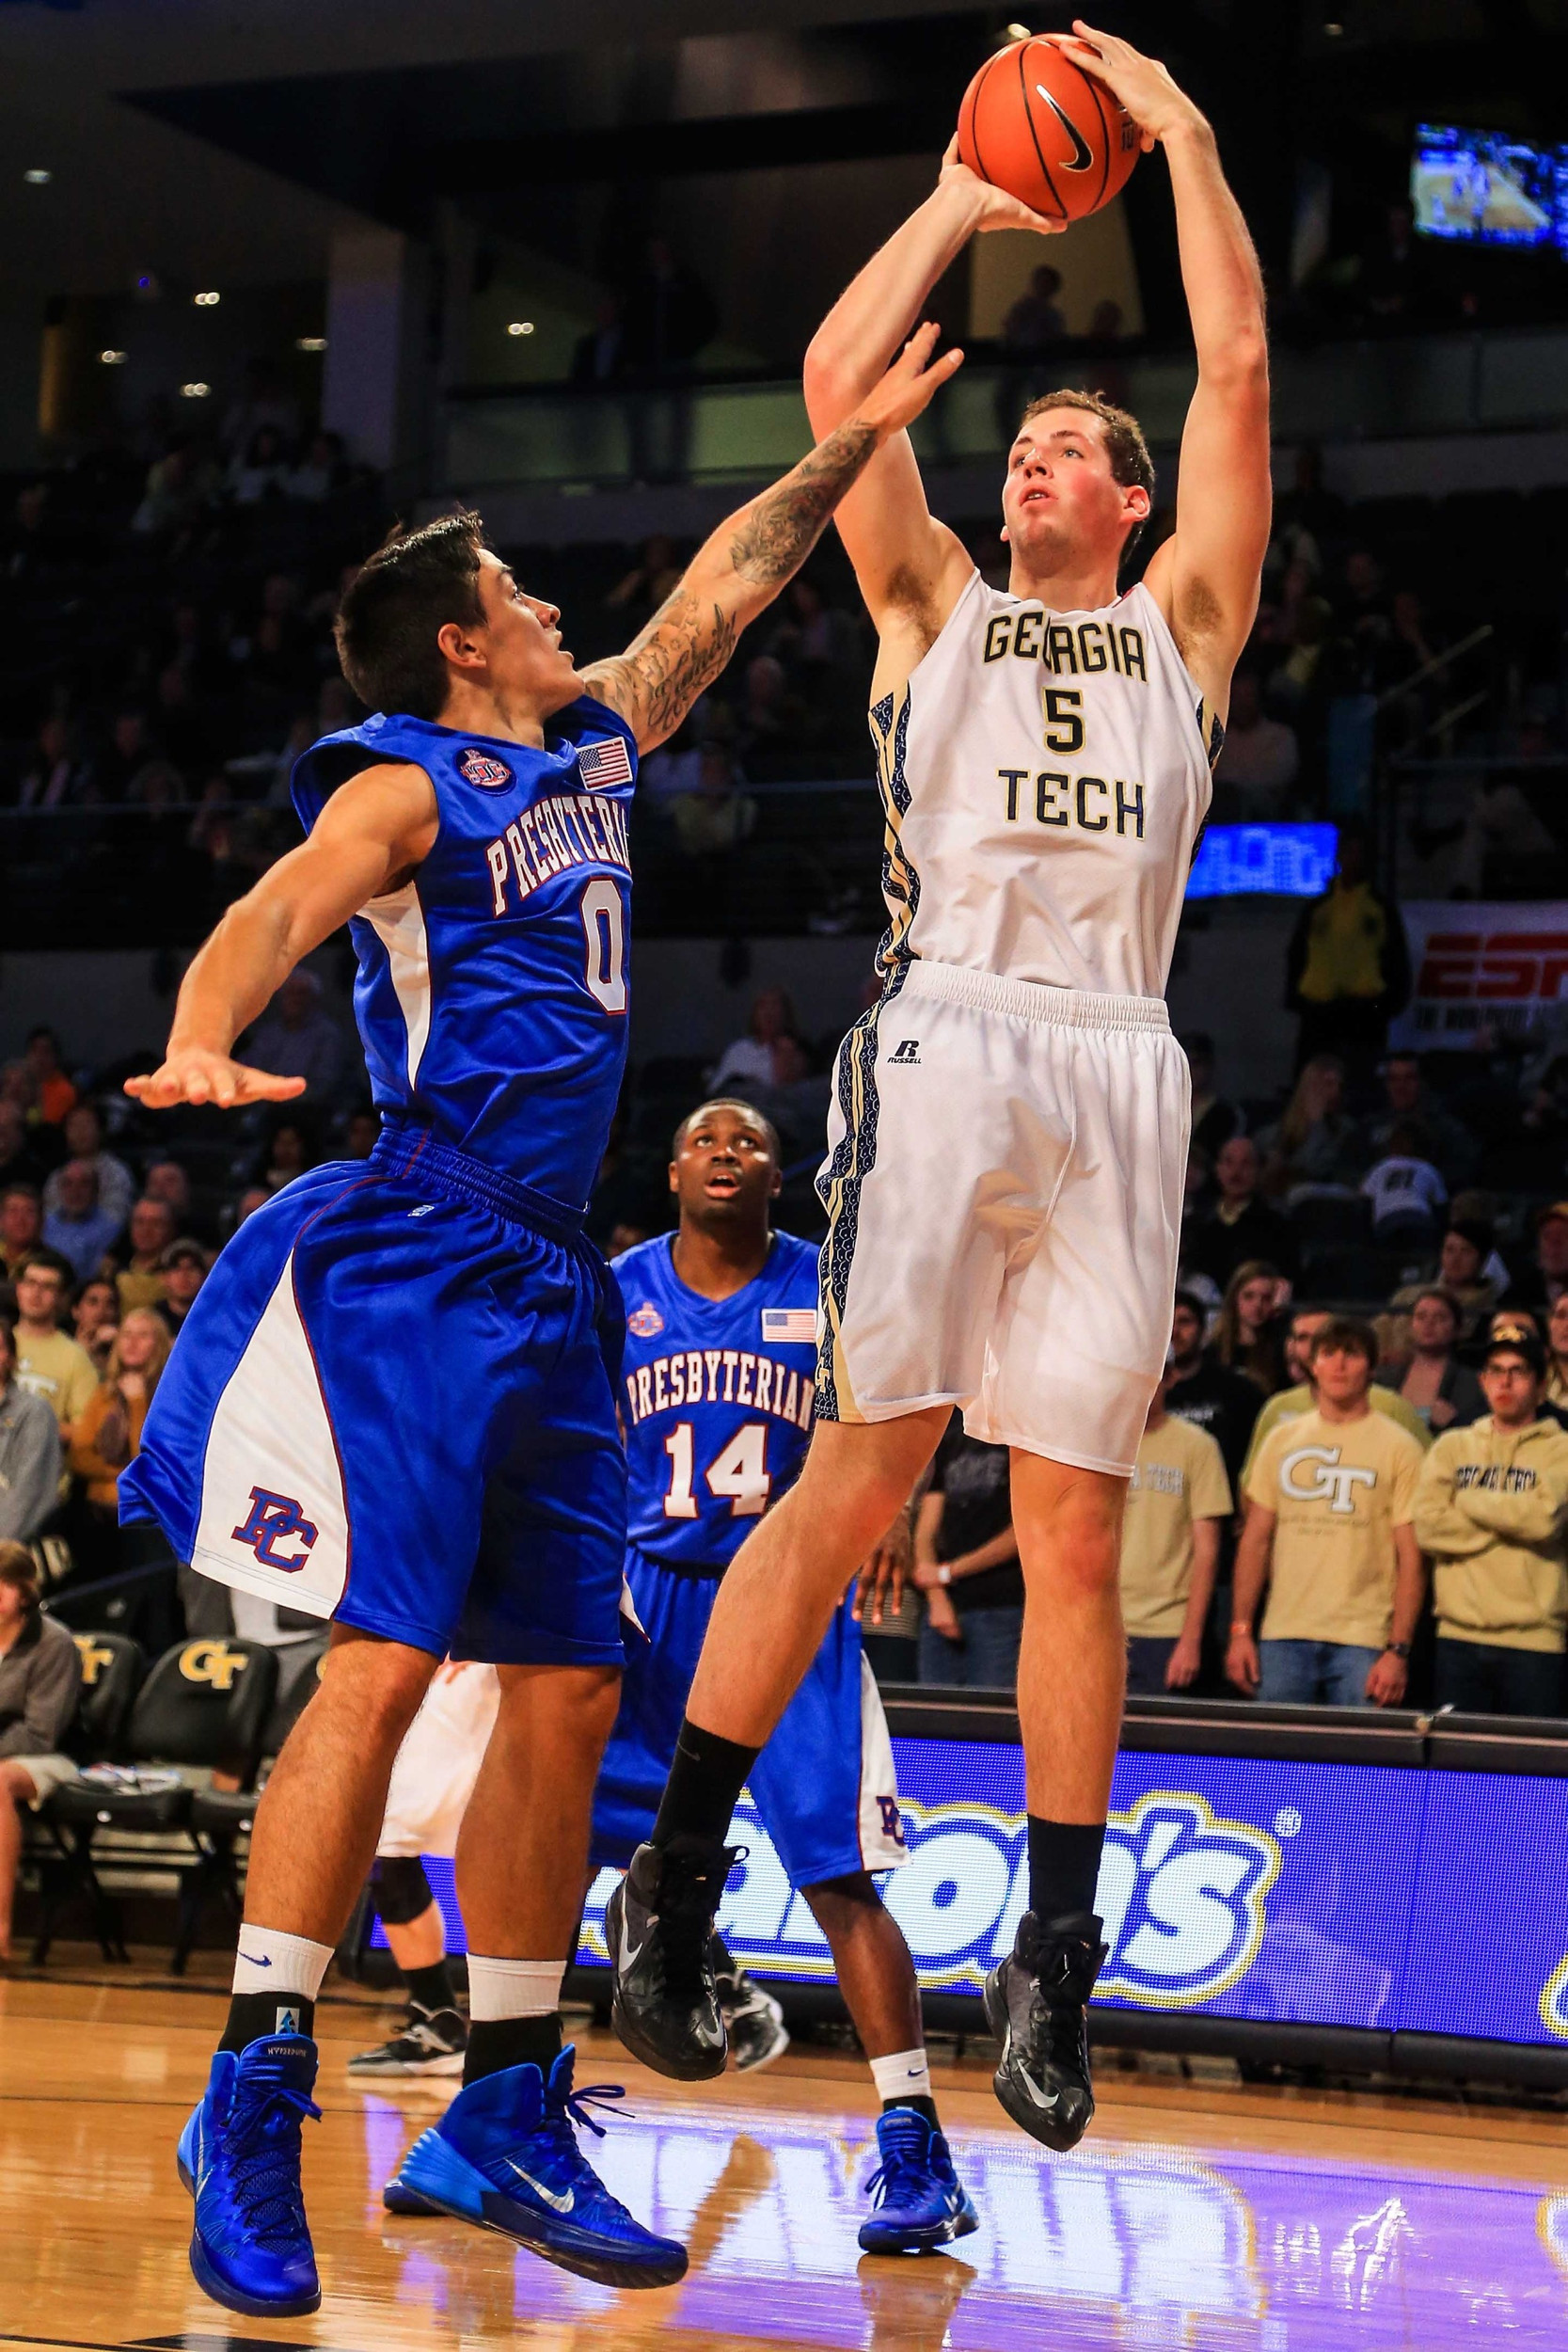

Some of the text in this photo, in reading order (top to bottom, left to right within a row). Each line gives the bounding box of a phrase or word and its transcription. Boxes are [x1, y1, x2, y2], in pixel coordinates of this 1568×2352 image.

[1042, 686, 1086, 755] 5
[997, 769, 1146, 841] TECH
[579, 875, 628, 1015] 0
[663, 1422, 772, 1520] 14
[1280, 1444, 1378, 1514] GT
[230, 1486, 319, 1573] PC
[179, 1640, 248, 1689] GT
